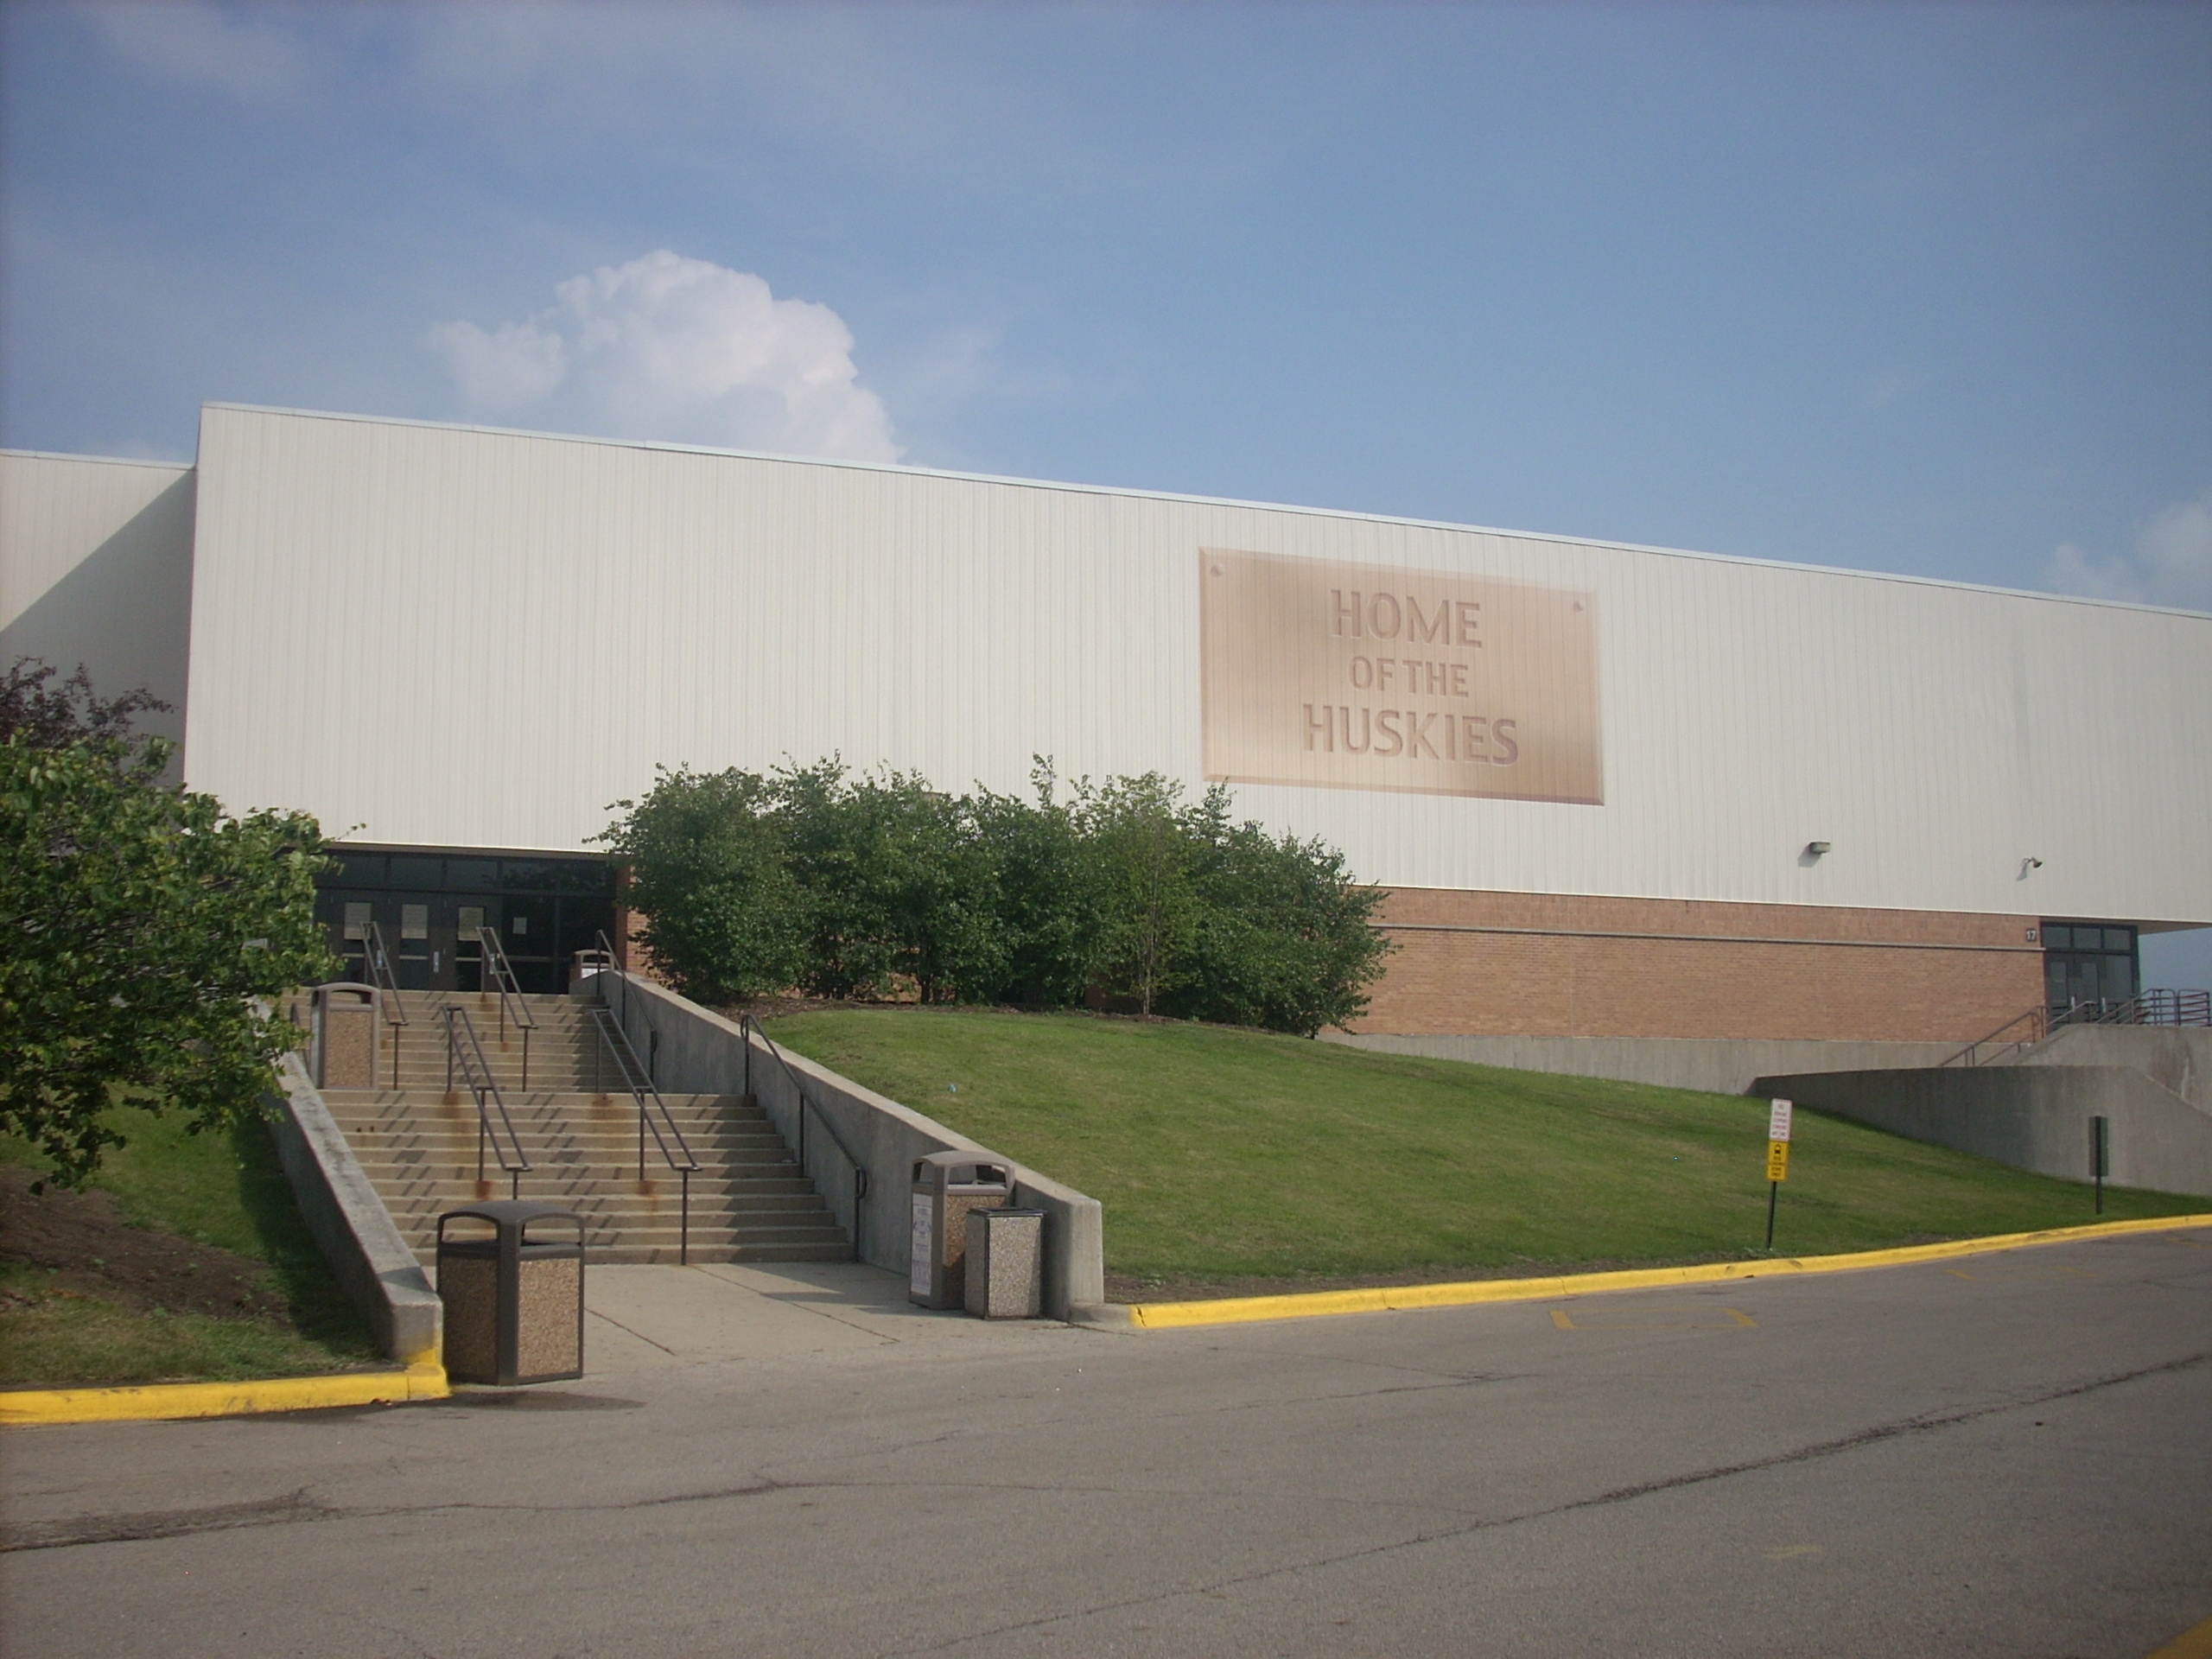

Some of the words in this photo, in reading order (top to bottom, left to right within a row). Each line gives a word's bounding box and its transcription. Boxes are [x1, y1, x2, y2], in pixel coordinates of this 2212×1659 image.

[1331, 589, 1483, 648] HOME
[1348, 656, 1395, 691] OF
[1402, 658, 1470, 698] THE
[1302, 703, 1519, 766] HUSKIES
[2026, 930, 2037, 941] 17
